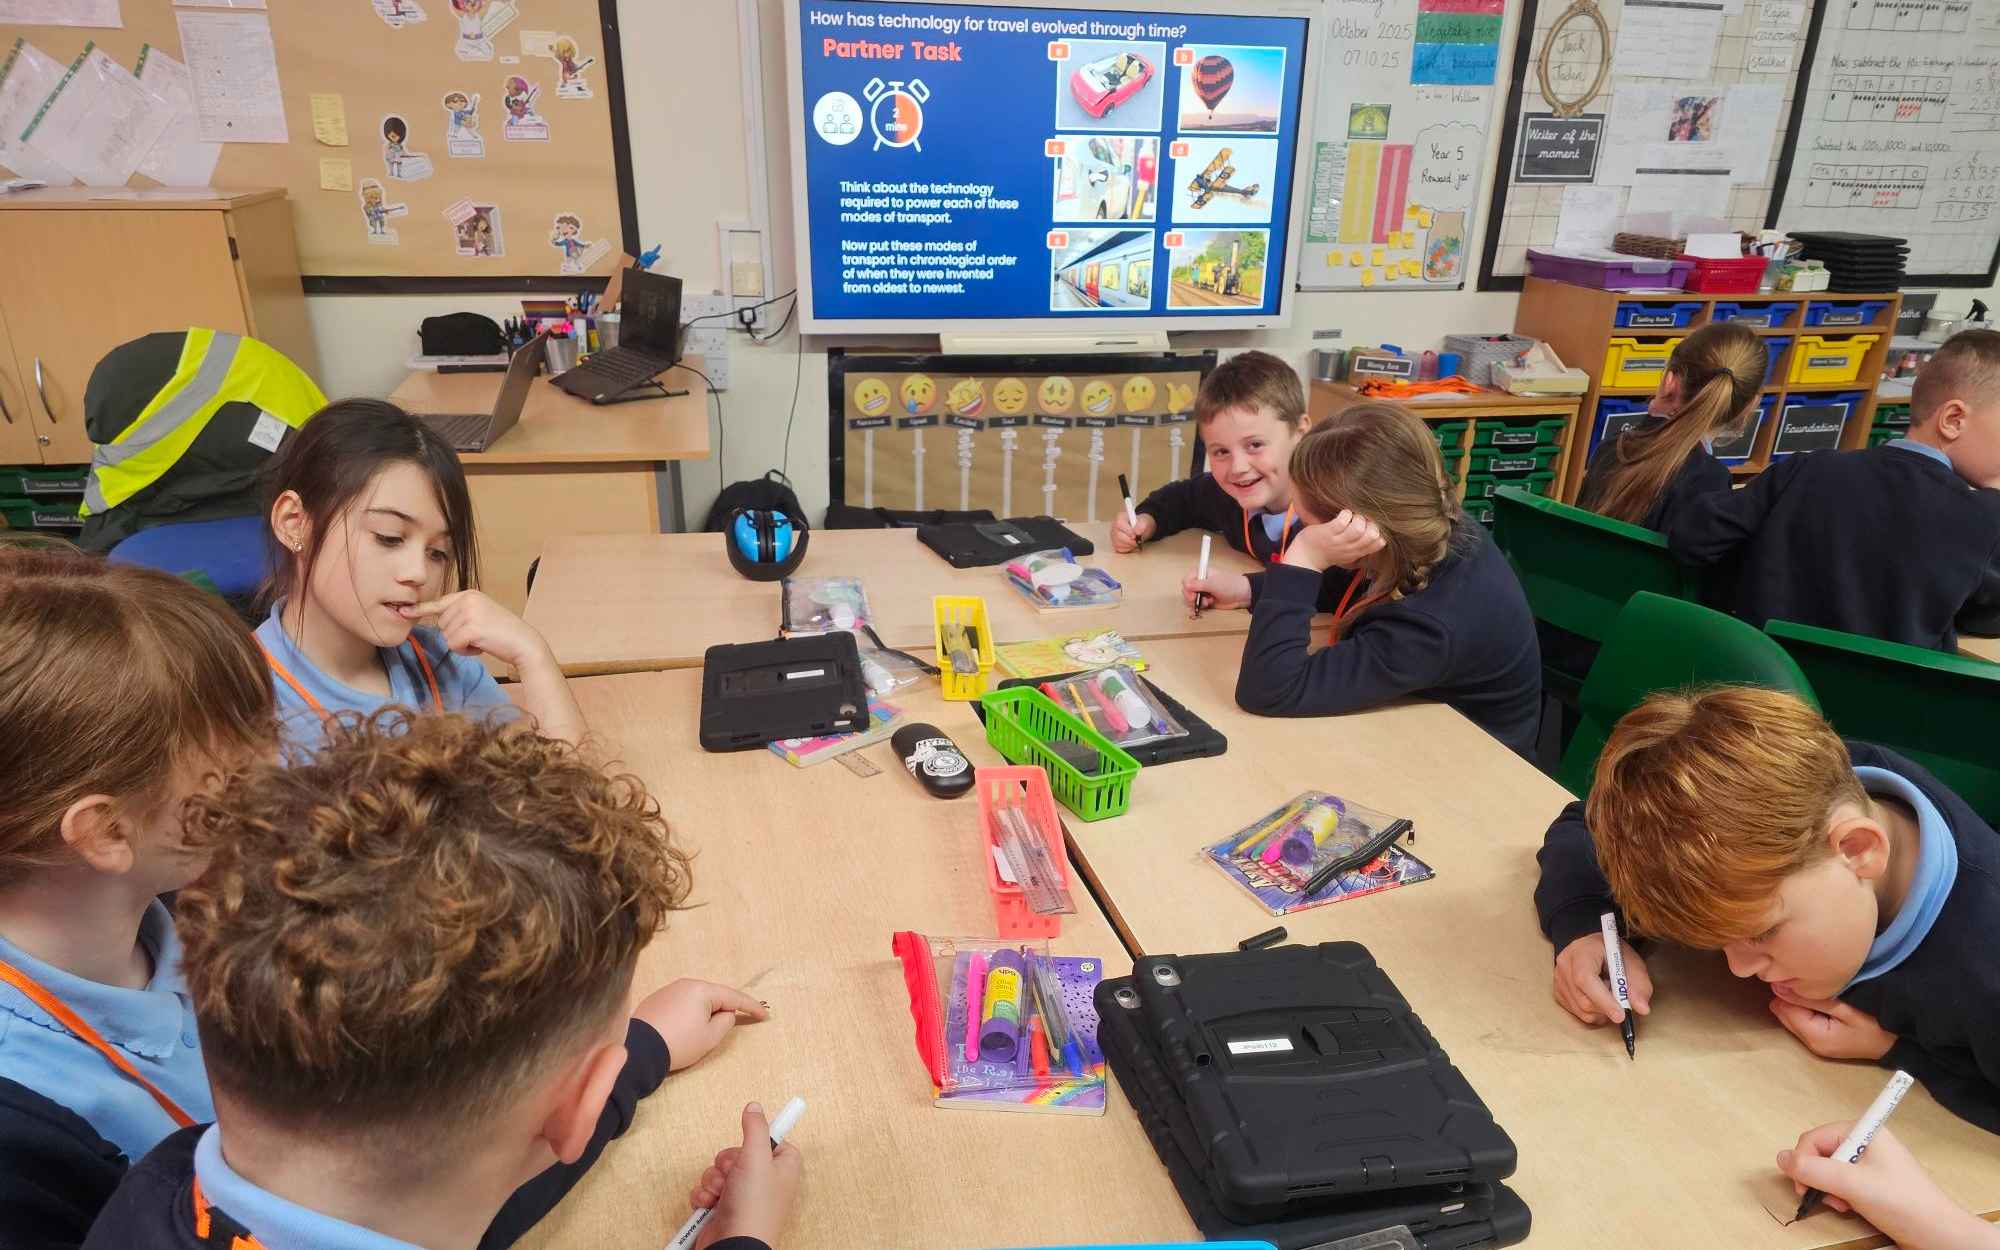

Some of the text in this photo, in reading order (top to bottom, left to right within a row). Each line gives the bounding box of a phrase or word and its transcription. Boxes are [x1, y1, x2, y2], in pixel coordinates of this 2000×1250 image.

[810, 11, 1187, 40] How has technology for travel evolved through time?
[1331, 17, 1413, 40] October 2025
[823, 39, 962, 61] Partner Task
[1888, 55, 1901, 68] the
[1529, 128, 1597, 144] Writer of the
[1431, 143, 1464, 161] Year 5
[1539, 149, 1580, 160] moment
[1422, 168, 1471, 190] Reward jar
[840, 181, 994, 197] Think about the technology
[840, 196, 1019, 211] required to power each of these
[841, 212, 952, 226] modes of transport.
[841, 240, 977, 253] Now put these modes of
[842, 254, 1017, 268] transport in chronological order
[842, 268, 994, 281] of when they were invented
[843, 282, 965, 294] from oldest to newest.
[1783, 421, 1840, 433] Foundation
